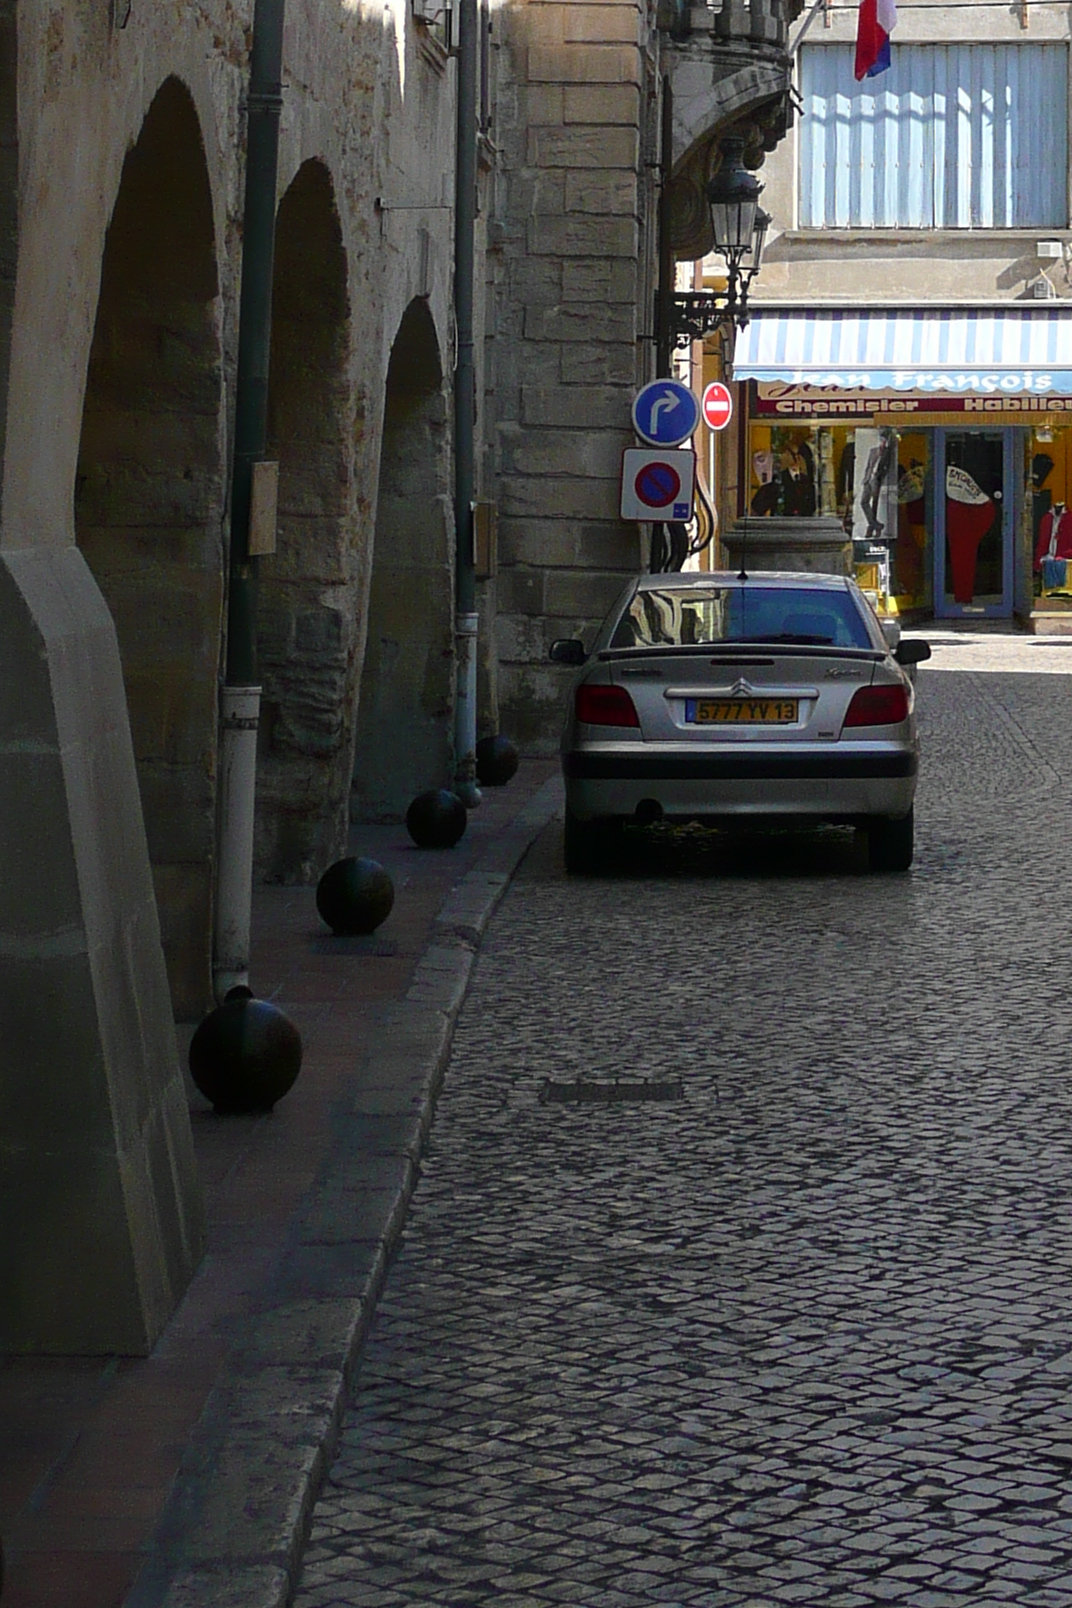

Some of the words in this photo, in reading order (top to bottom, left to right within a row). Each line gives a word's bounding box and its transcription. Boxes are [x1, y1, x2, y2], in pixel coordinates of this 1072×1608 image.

[790, 370, 871, 387] Jean
[891, 370, 1054, 393] François
[775, 399, 919, 413] Chemisier
[698, 702, 743, 720] 5777
[747, 702, 770, 720] YV
[774, 701, 796, 720] 13
